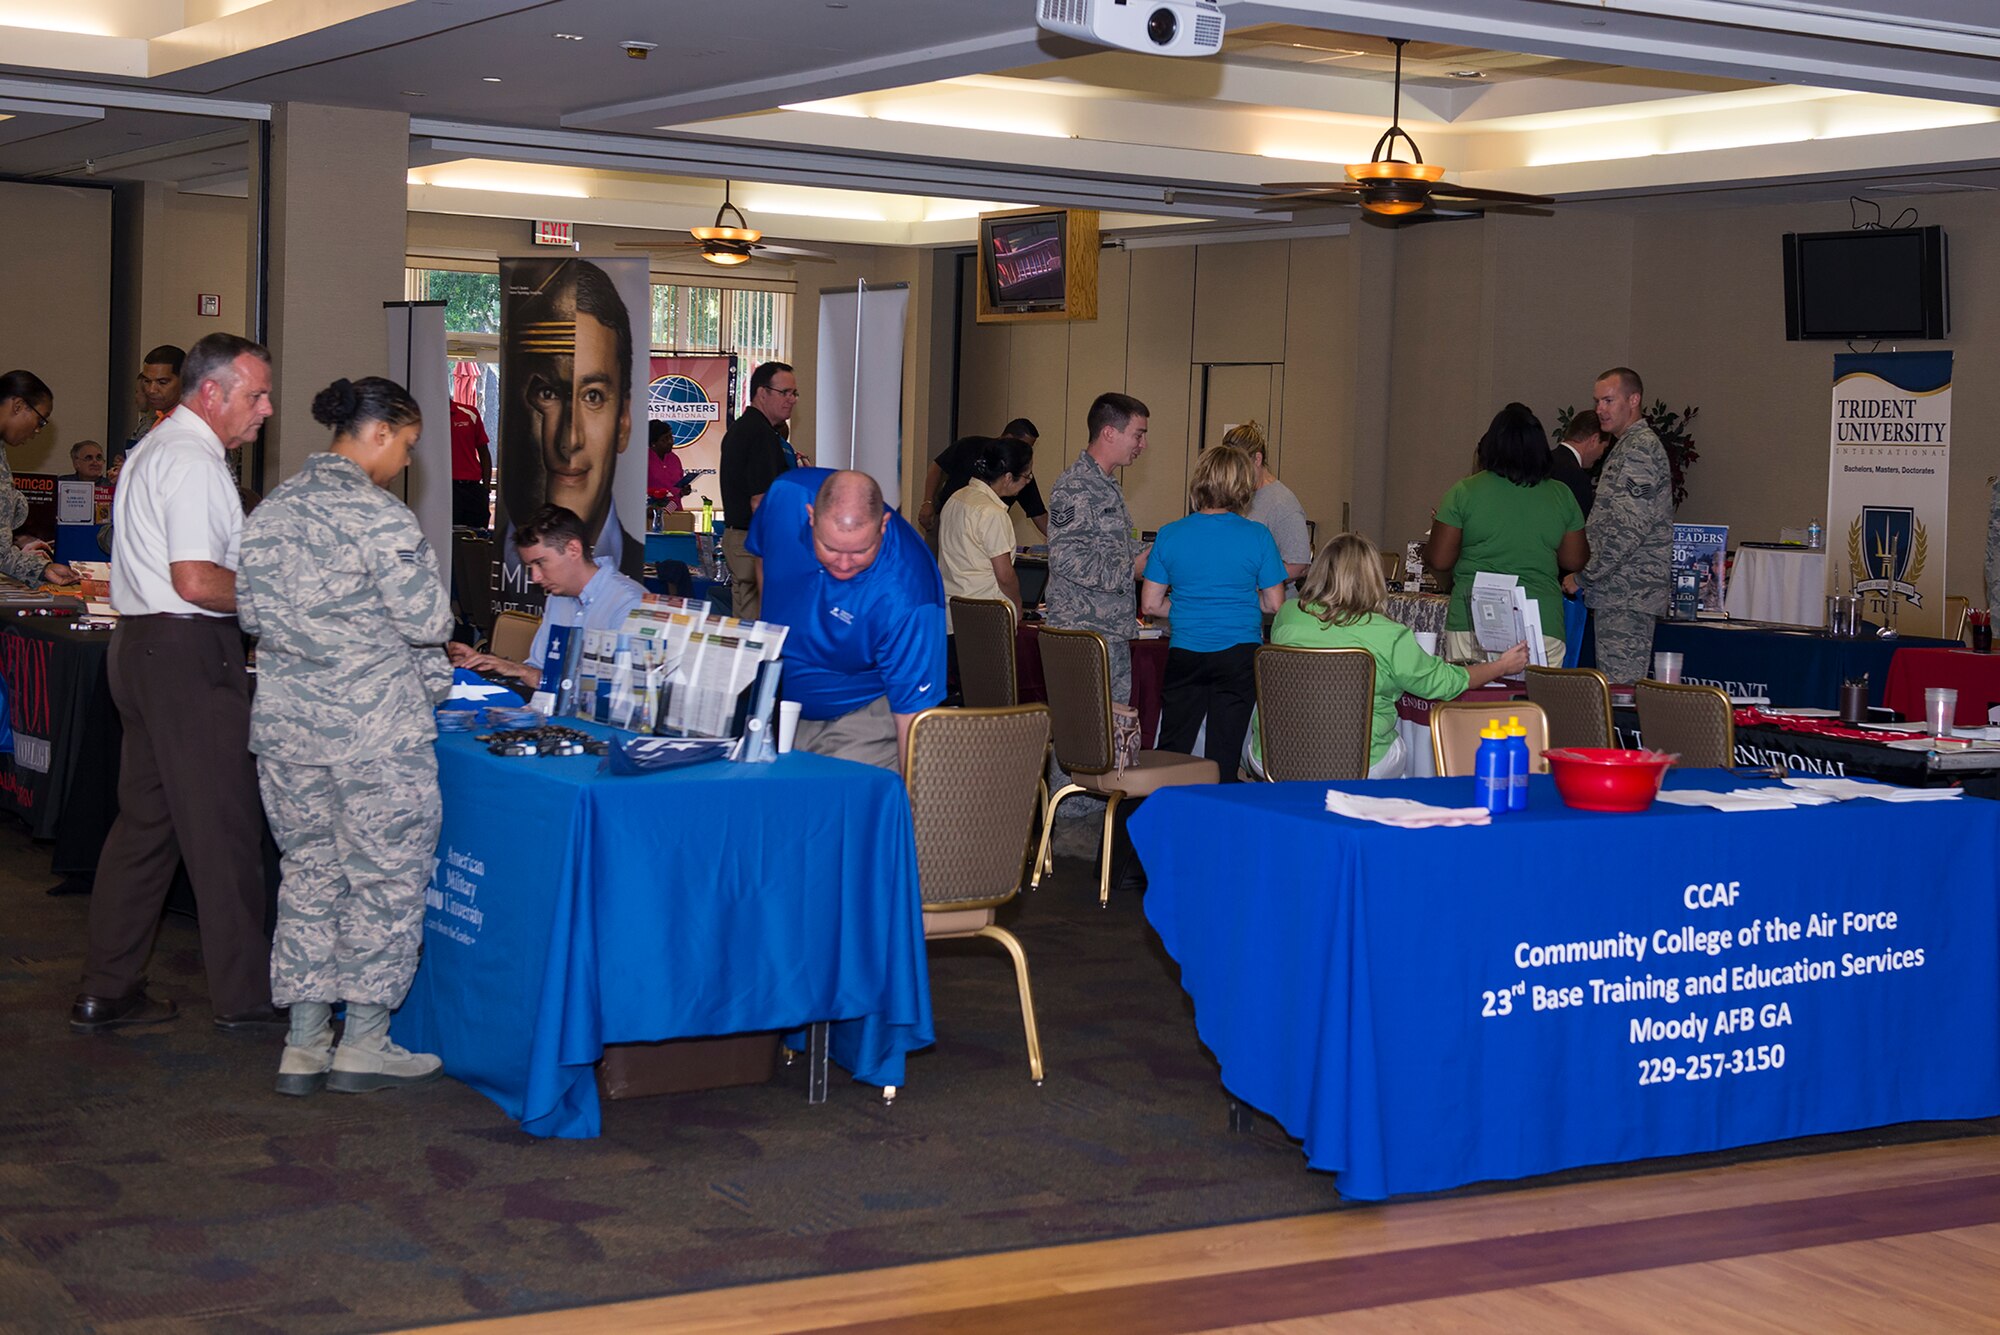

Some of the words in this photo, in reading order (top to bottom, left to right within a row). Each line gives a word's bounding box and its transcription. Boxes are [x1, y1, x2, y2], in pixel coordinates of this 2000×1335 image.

[541, 221, 569, 244] EXIT
[1838, 400, 1917, 419] TRIDENT
[1837, 423, 1946, 442] UNIVERSITY
[1836, 448, 1945, 456] INTERNATIONAL
[1844, 465, 1874, 474] Bachelors,
[1875, 466, 1900, 474] Masters,
[1902, 467, 1934, 475] Doctorates
[1672, 532, 1724, 543] LEADERS
[1676, 593, 1695, 601] LEAD
[446, 846, 484, 876] American
[445, 868, 477, 904] Military
[1684, 882, 1740, 910] CCAF
[1515, 932, 1647, 968] Community
[1652, 926, 1732, 957] College
[1737, 920, 1761, 946] of
[1764, 918, 1801, 943] the
[1806, 912, 1837, 938] Air
[1842, 909, 1898, 934] Force
[1482, 980, 1525, 1018] 23rd
[1532, 984, 1583, 1012] Base
[1589, 974, 1680, 1003] Training
[1685, 969, 1726, 996] and
[1731, 958, 1836, 991] Education
[1841, 947, 1925, 978] Services
[1630, 1013, 1708, 1044] Moody
[1714, 1006, 1754, 1036] AFB
[1759, 1002, 1792, 1029] GA
[1638, 1044, 1786, 1087] 229-257-3150
